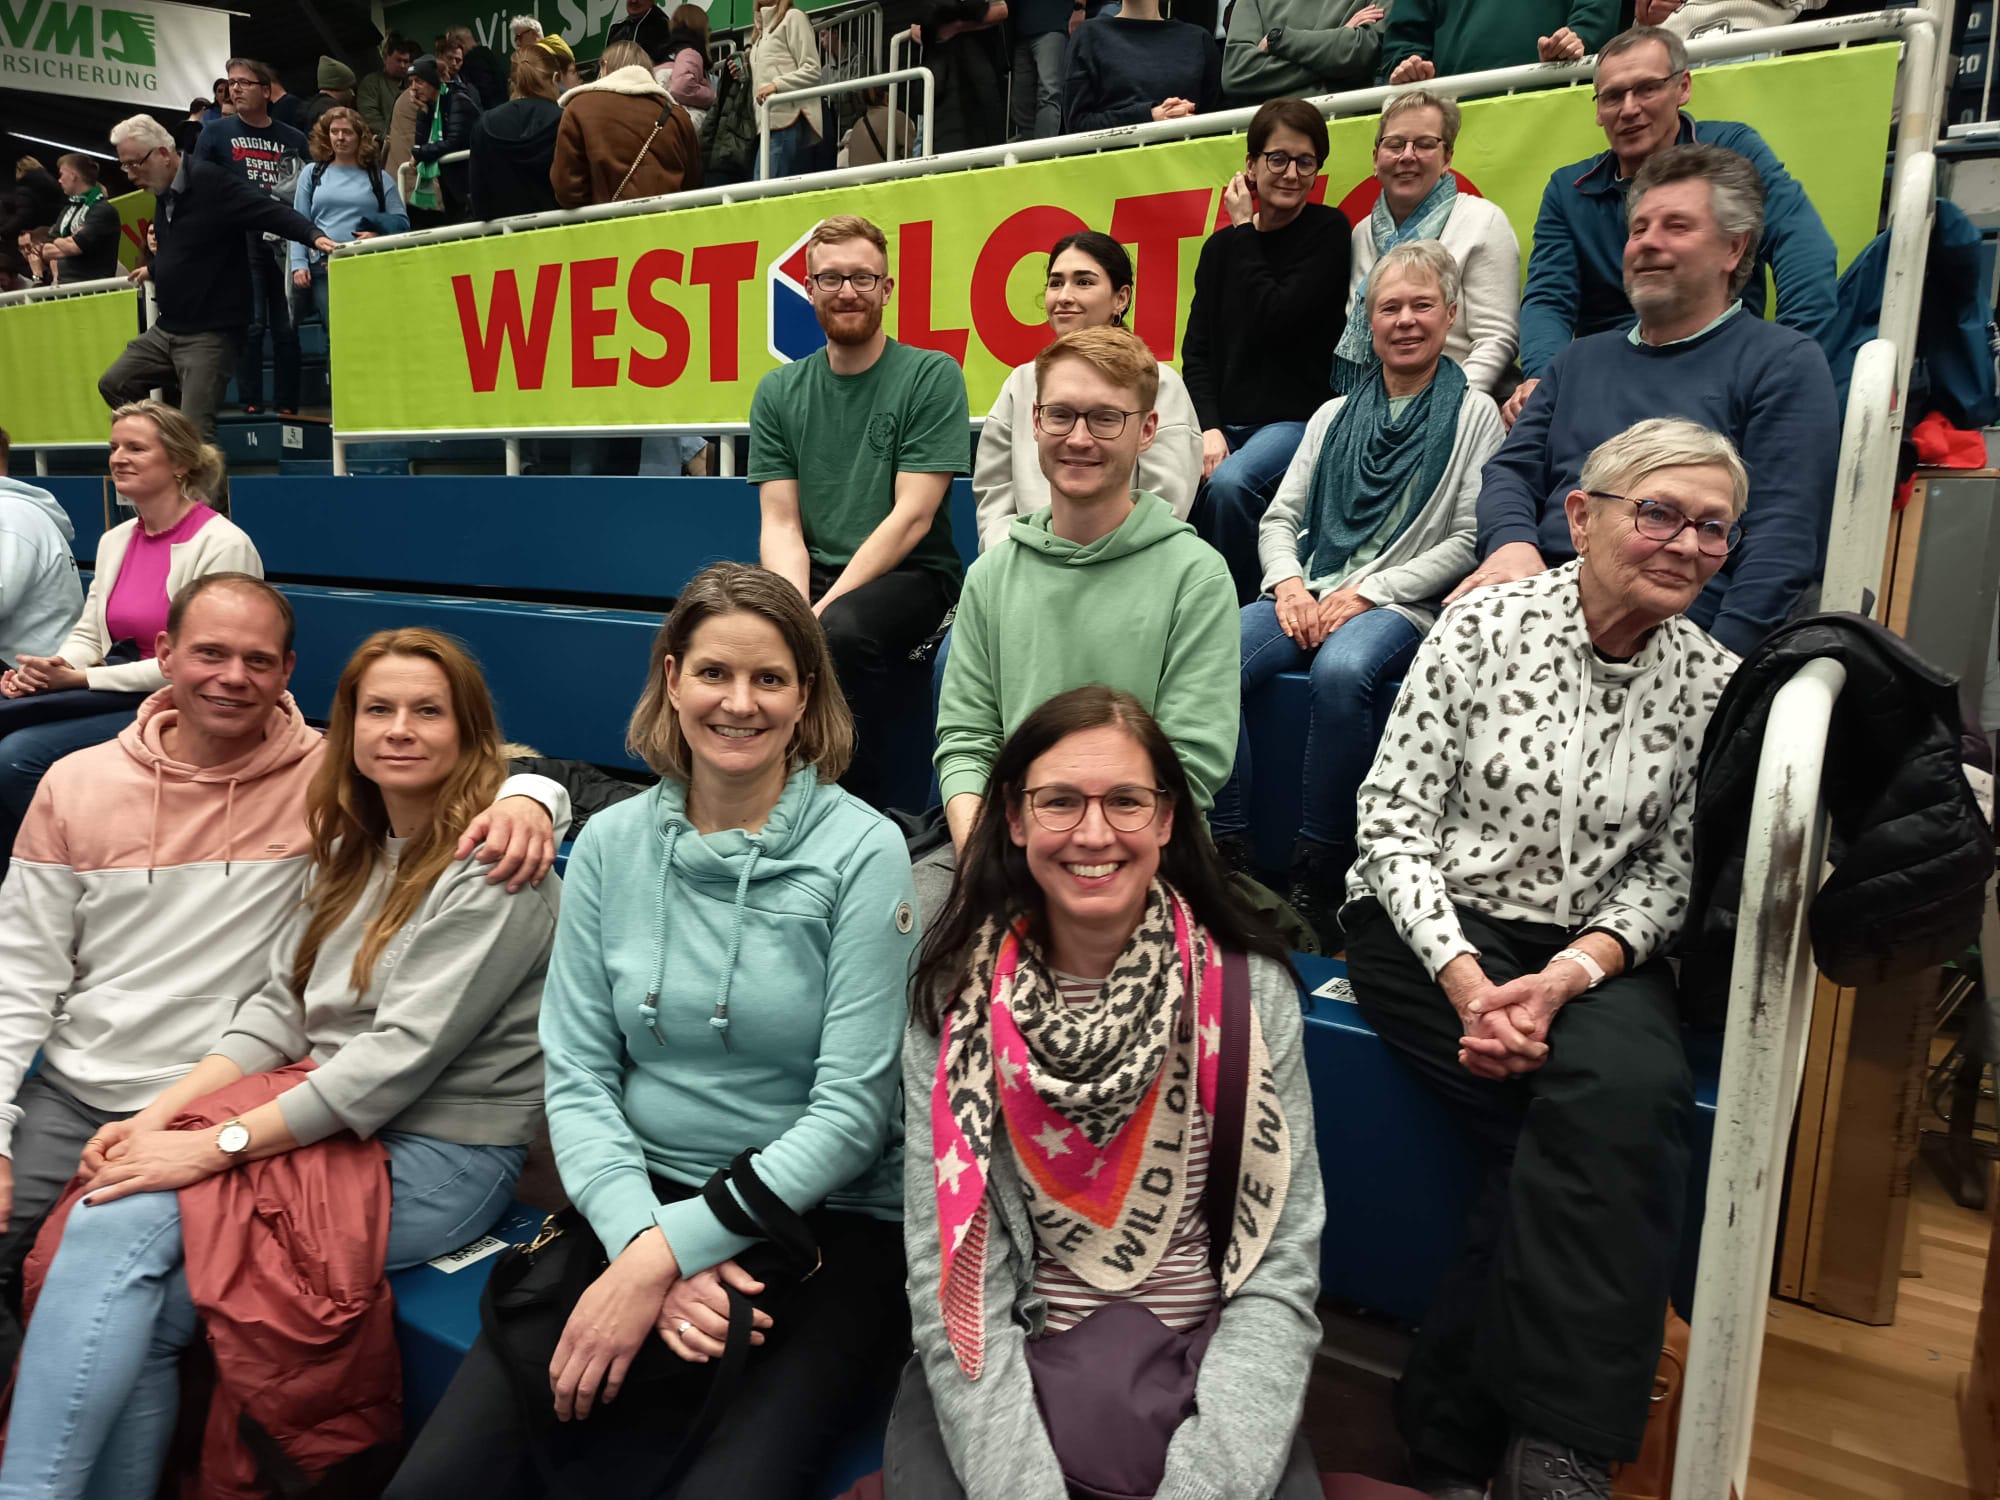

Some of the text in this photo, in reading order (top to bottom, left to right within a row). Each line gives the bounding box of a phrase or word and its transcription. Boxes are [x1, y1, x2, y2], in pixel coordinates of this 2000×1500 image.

[0, 0, 94, 58] VM
[0, 54, 157, 91] RSICHERUNG
[451, 168, 1485, 393] WEST LOT
[247, 432, 258, 446] 14
[1020, 1022, 1193, 1274] OVE WILD LOVE
[1224, 1172, 1275, 1275] OVE
